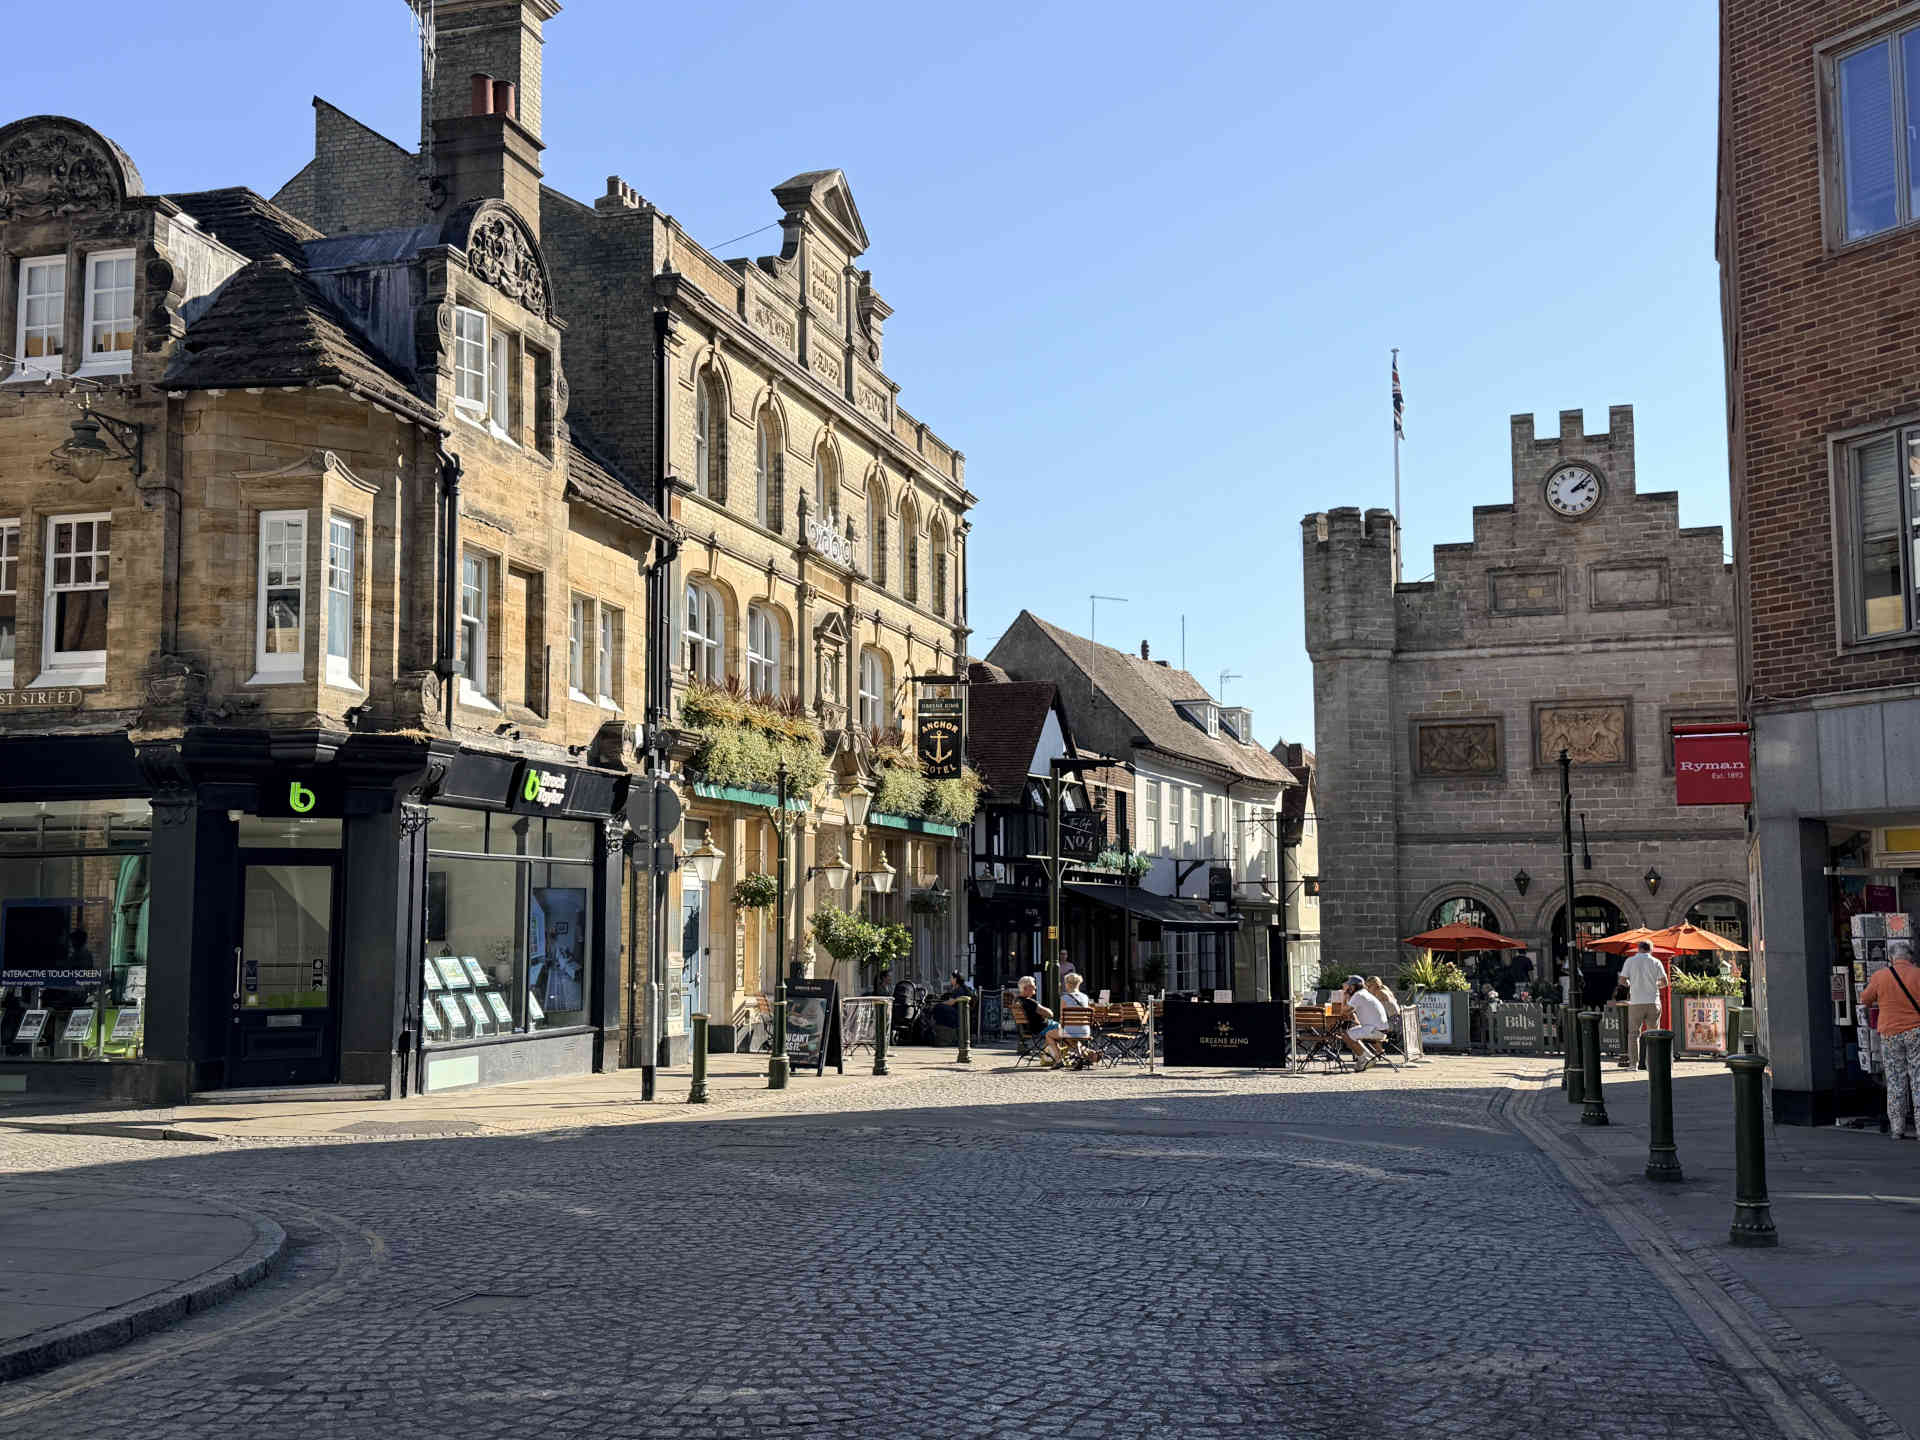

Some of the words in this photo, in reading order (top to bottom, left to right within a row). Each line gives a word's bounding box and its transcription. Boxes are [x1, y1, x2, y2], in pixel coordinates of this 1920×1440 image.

[20, 691, 76, 705] STREET
[922, 721, 959, 734] ANCHOR
[1680, 761, 1745, 772] Ryman
[2, 969, 46, 978] INTERACTIVE
[47, 969, 73, 978] TOUCH
[74, 969, 102, 978] SCREEN
